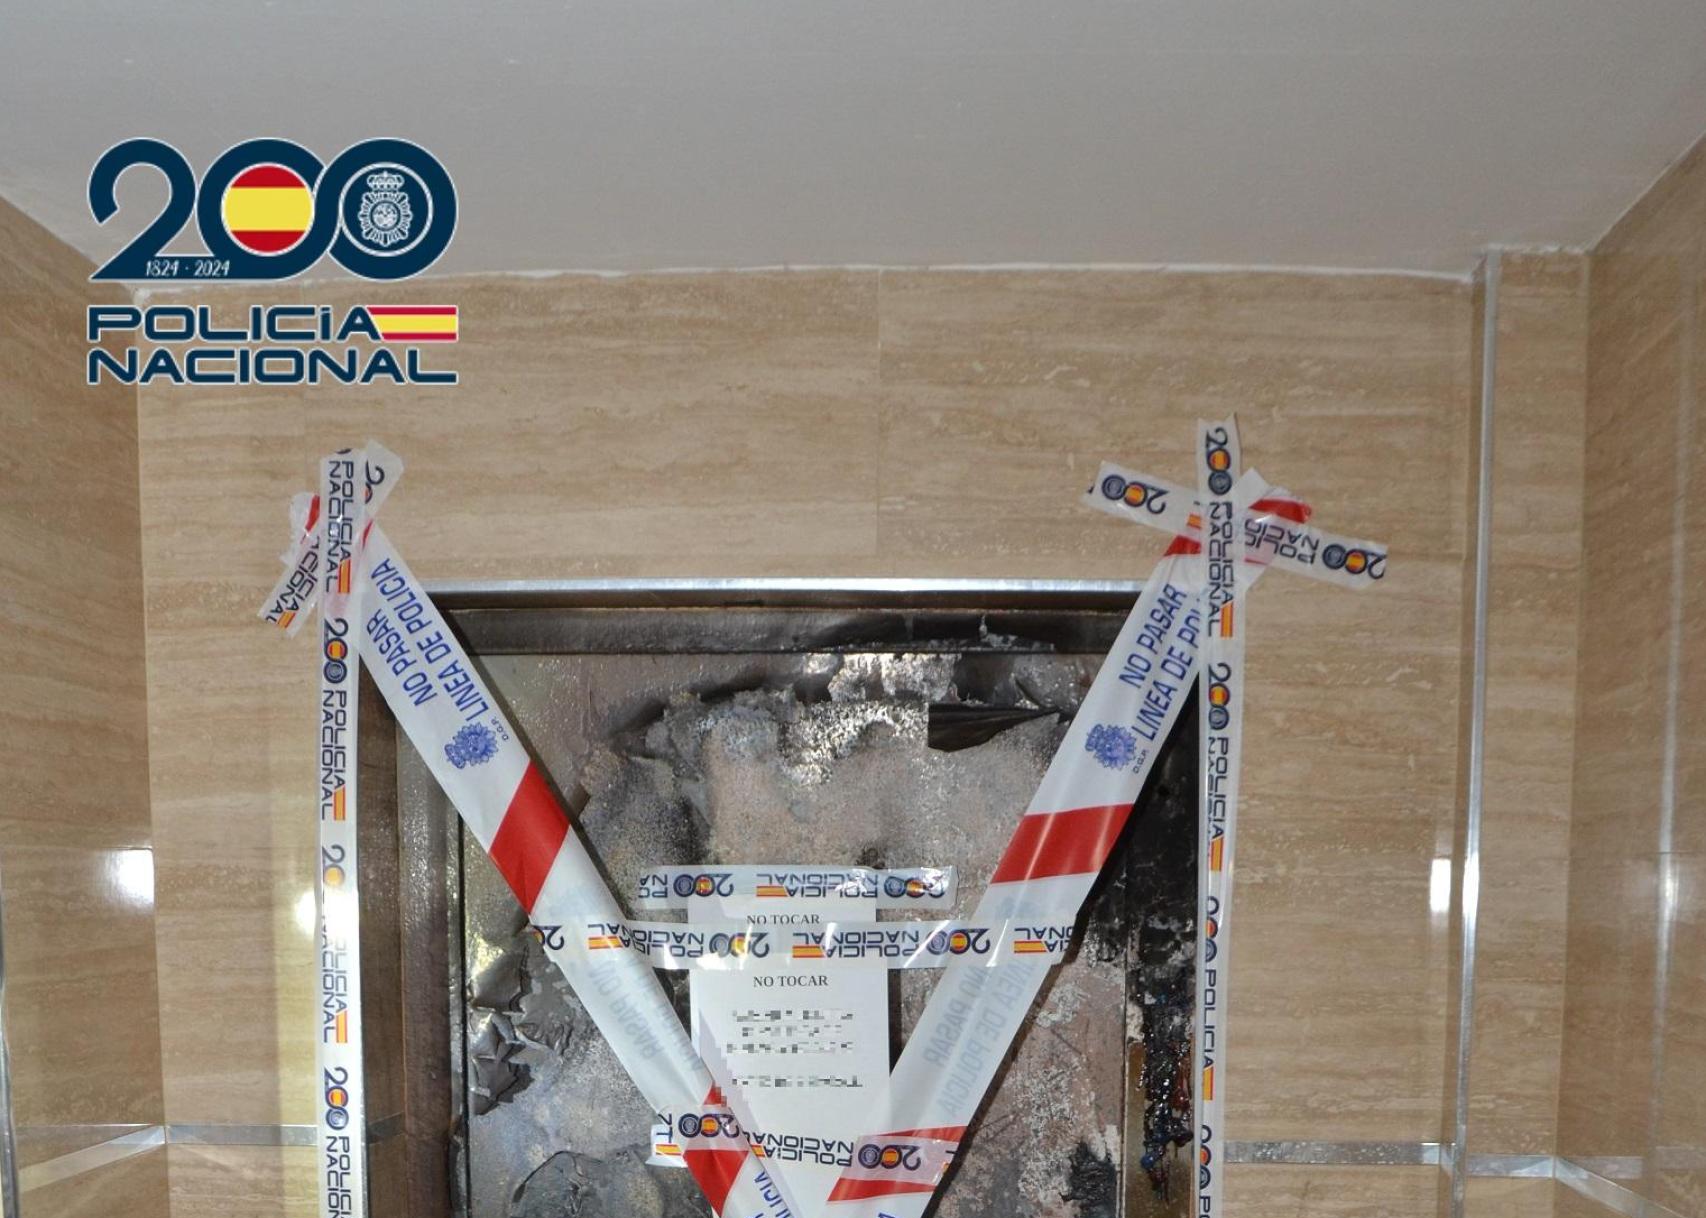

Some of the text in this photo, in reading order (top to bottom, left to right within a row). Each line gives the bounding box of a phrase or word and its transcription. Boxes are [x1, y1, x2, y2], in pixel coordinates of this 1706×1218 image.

[325, 461, 341, 593] NACIONAL
[1208, 502, 1221, 637] NACIONAL
[1245, 518, 1320, 551] NACIO
[1245, 533, 1316, 565] POLIC
[366, 608, 438, 706] NO PASAR
[370, 558, 489, 722] LINEA DE POLICIA
[1119, 583, 1187, 689] NO PASAR
[1131, 680, 1178, 741] LINEA
[1160, 646, 1194, 680] DE
[321, 690, 334, 821] NACIONAL
[770, 914, 821, 924] TOCAR
[793, 930, 919, 945] NACIONAL
[753, 975, 829, 987] NO TOCAR
